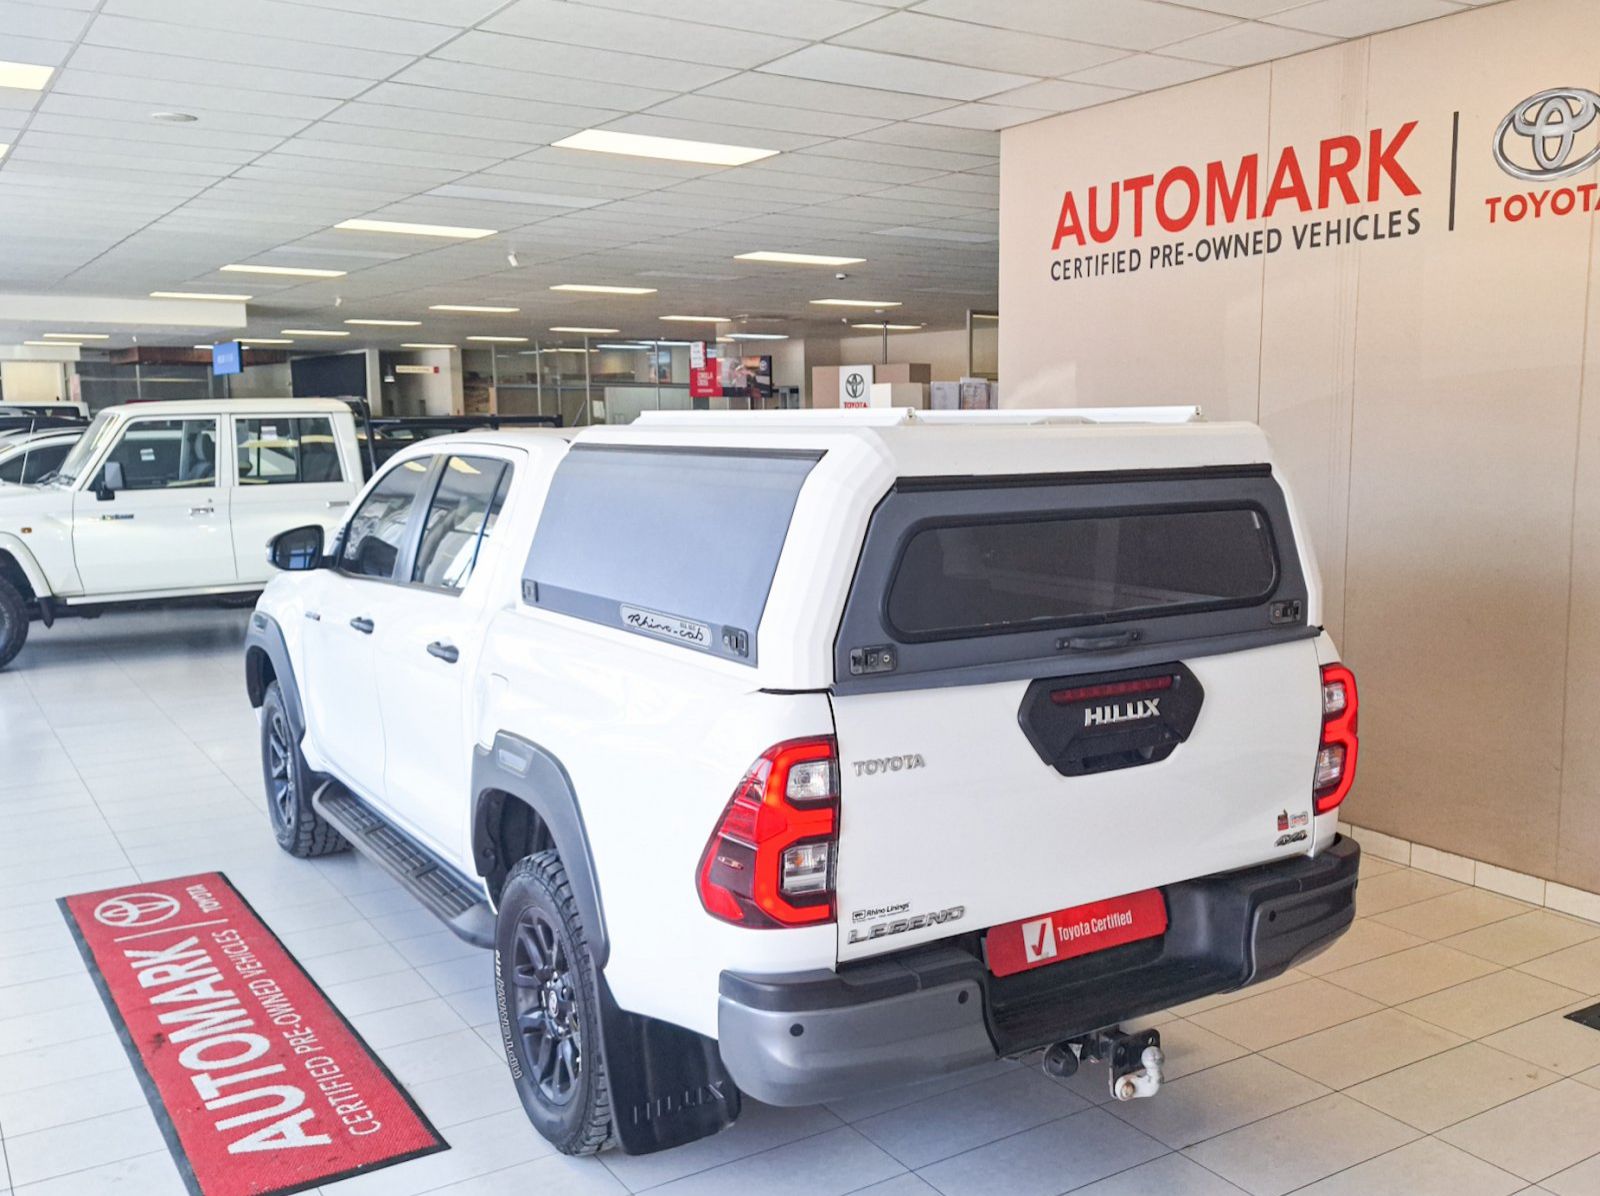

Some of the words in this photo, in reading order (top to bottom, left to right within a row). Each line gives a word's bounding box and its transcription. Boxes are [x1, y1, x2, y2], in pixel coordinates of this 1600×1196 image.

[1051, 119, 1422, 250] AUTOMARK
[1051, 248, 1141, 281] CERTIFIED
[1150, 227, 1282, 270] PRE-OWNED
[1292, 207, 1422, 251] VEHICLES
[1084, 698, 1160, 727] HILUX
[853, 753, 926, 777] TOYOTA
[210, 928, 266, 980] VEHICLES
[1058, 921, 1091, 942] Toyota
[1091, 909, 1133, 933] Certified
[123, 936, 333, 1155] AUTOMARK
[247, 978, 324, 1055] PRE-OWNED
[304, 1055, 382, 1137] CERTIFIED
